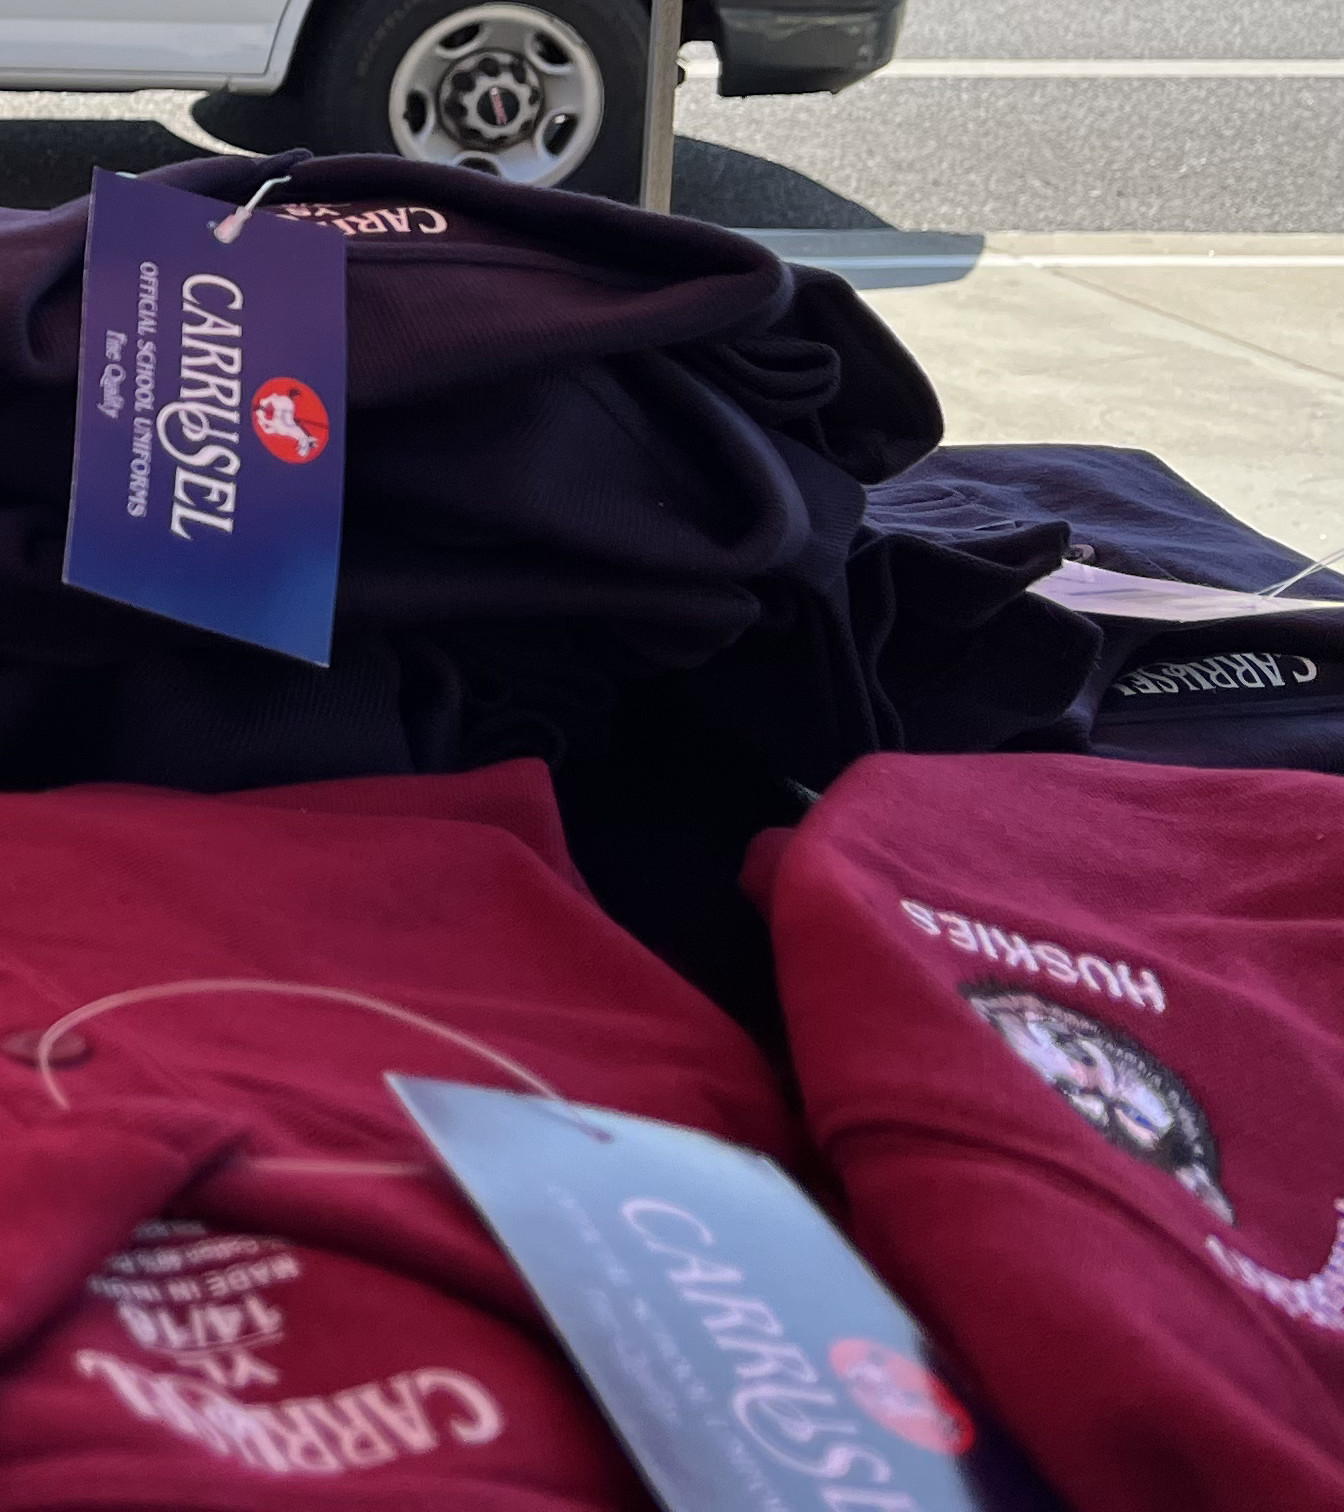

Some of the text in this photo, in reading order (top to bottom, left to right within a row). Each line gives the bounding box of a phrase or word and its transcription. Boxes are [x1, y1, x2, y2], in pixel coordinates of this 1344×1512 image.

[127, 261, 160, 518] OFFICIAL SCHOOL UNIFORMS
[155, 273, 244, 541] CARRUSEL
[900, 898, 1167, 1014] HUSKIES
